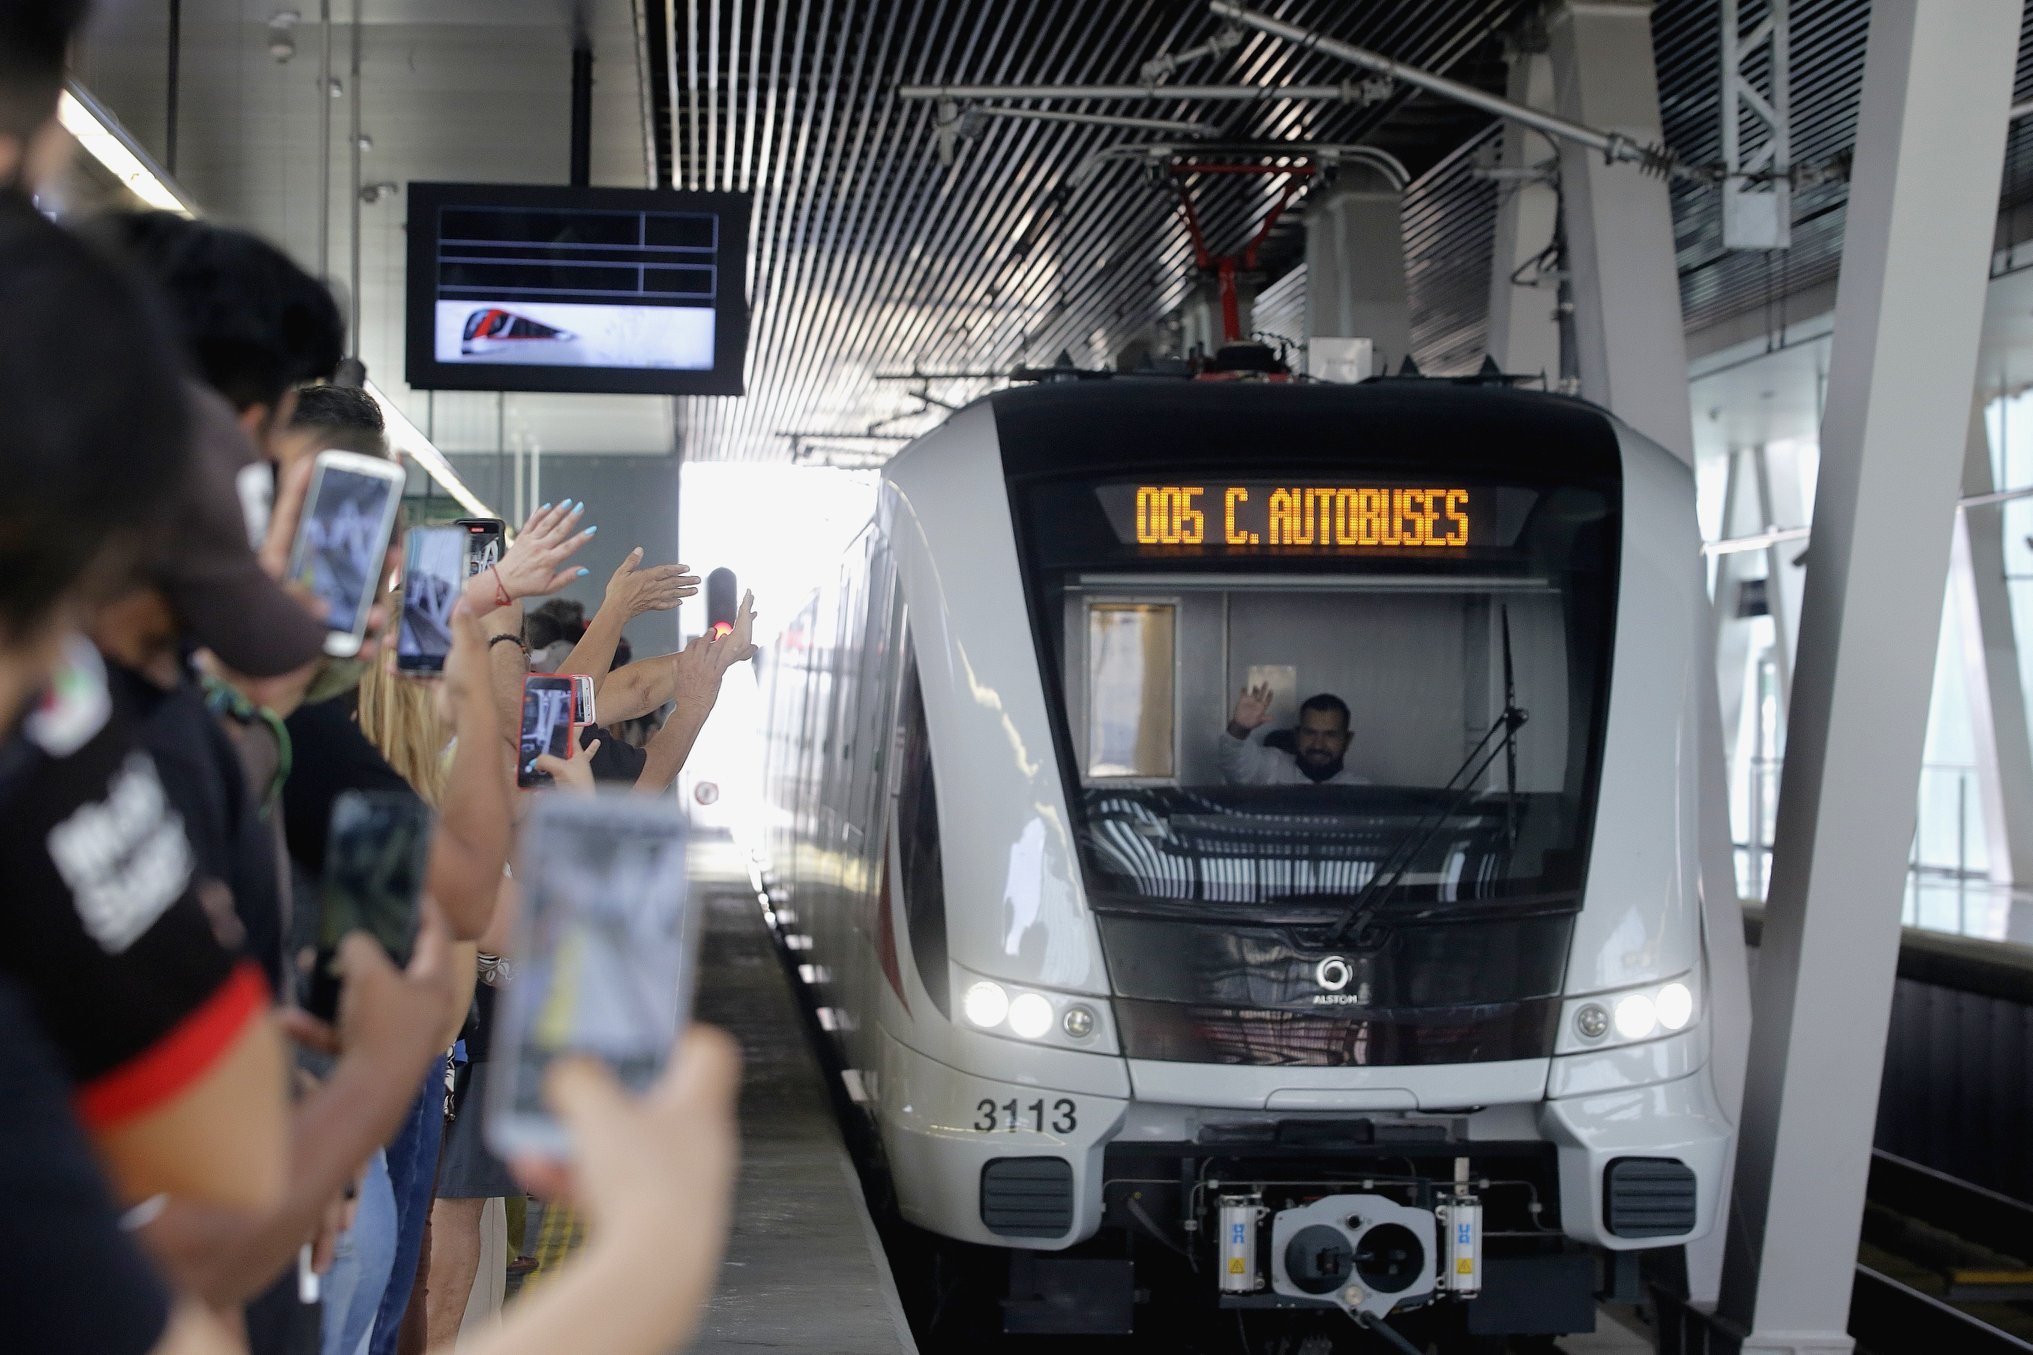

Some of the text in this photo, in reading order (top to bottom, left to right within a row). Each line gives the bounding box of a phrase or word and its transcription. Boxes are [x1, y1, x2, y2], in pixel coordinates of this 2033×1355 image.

[1136, 487, 1469, 546] 005 C. AUTOBUSES
[1313, 994, 1358, 1005] ALSTOM
[974, 1098, 1077, 1134] 3113
